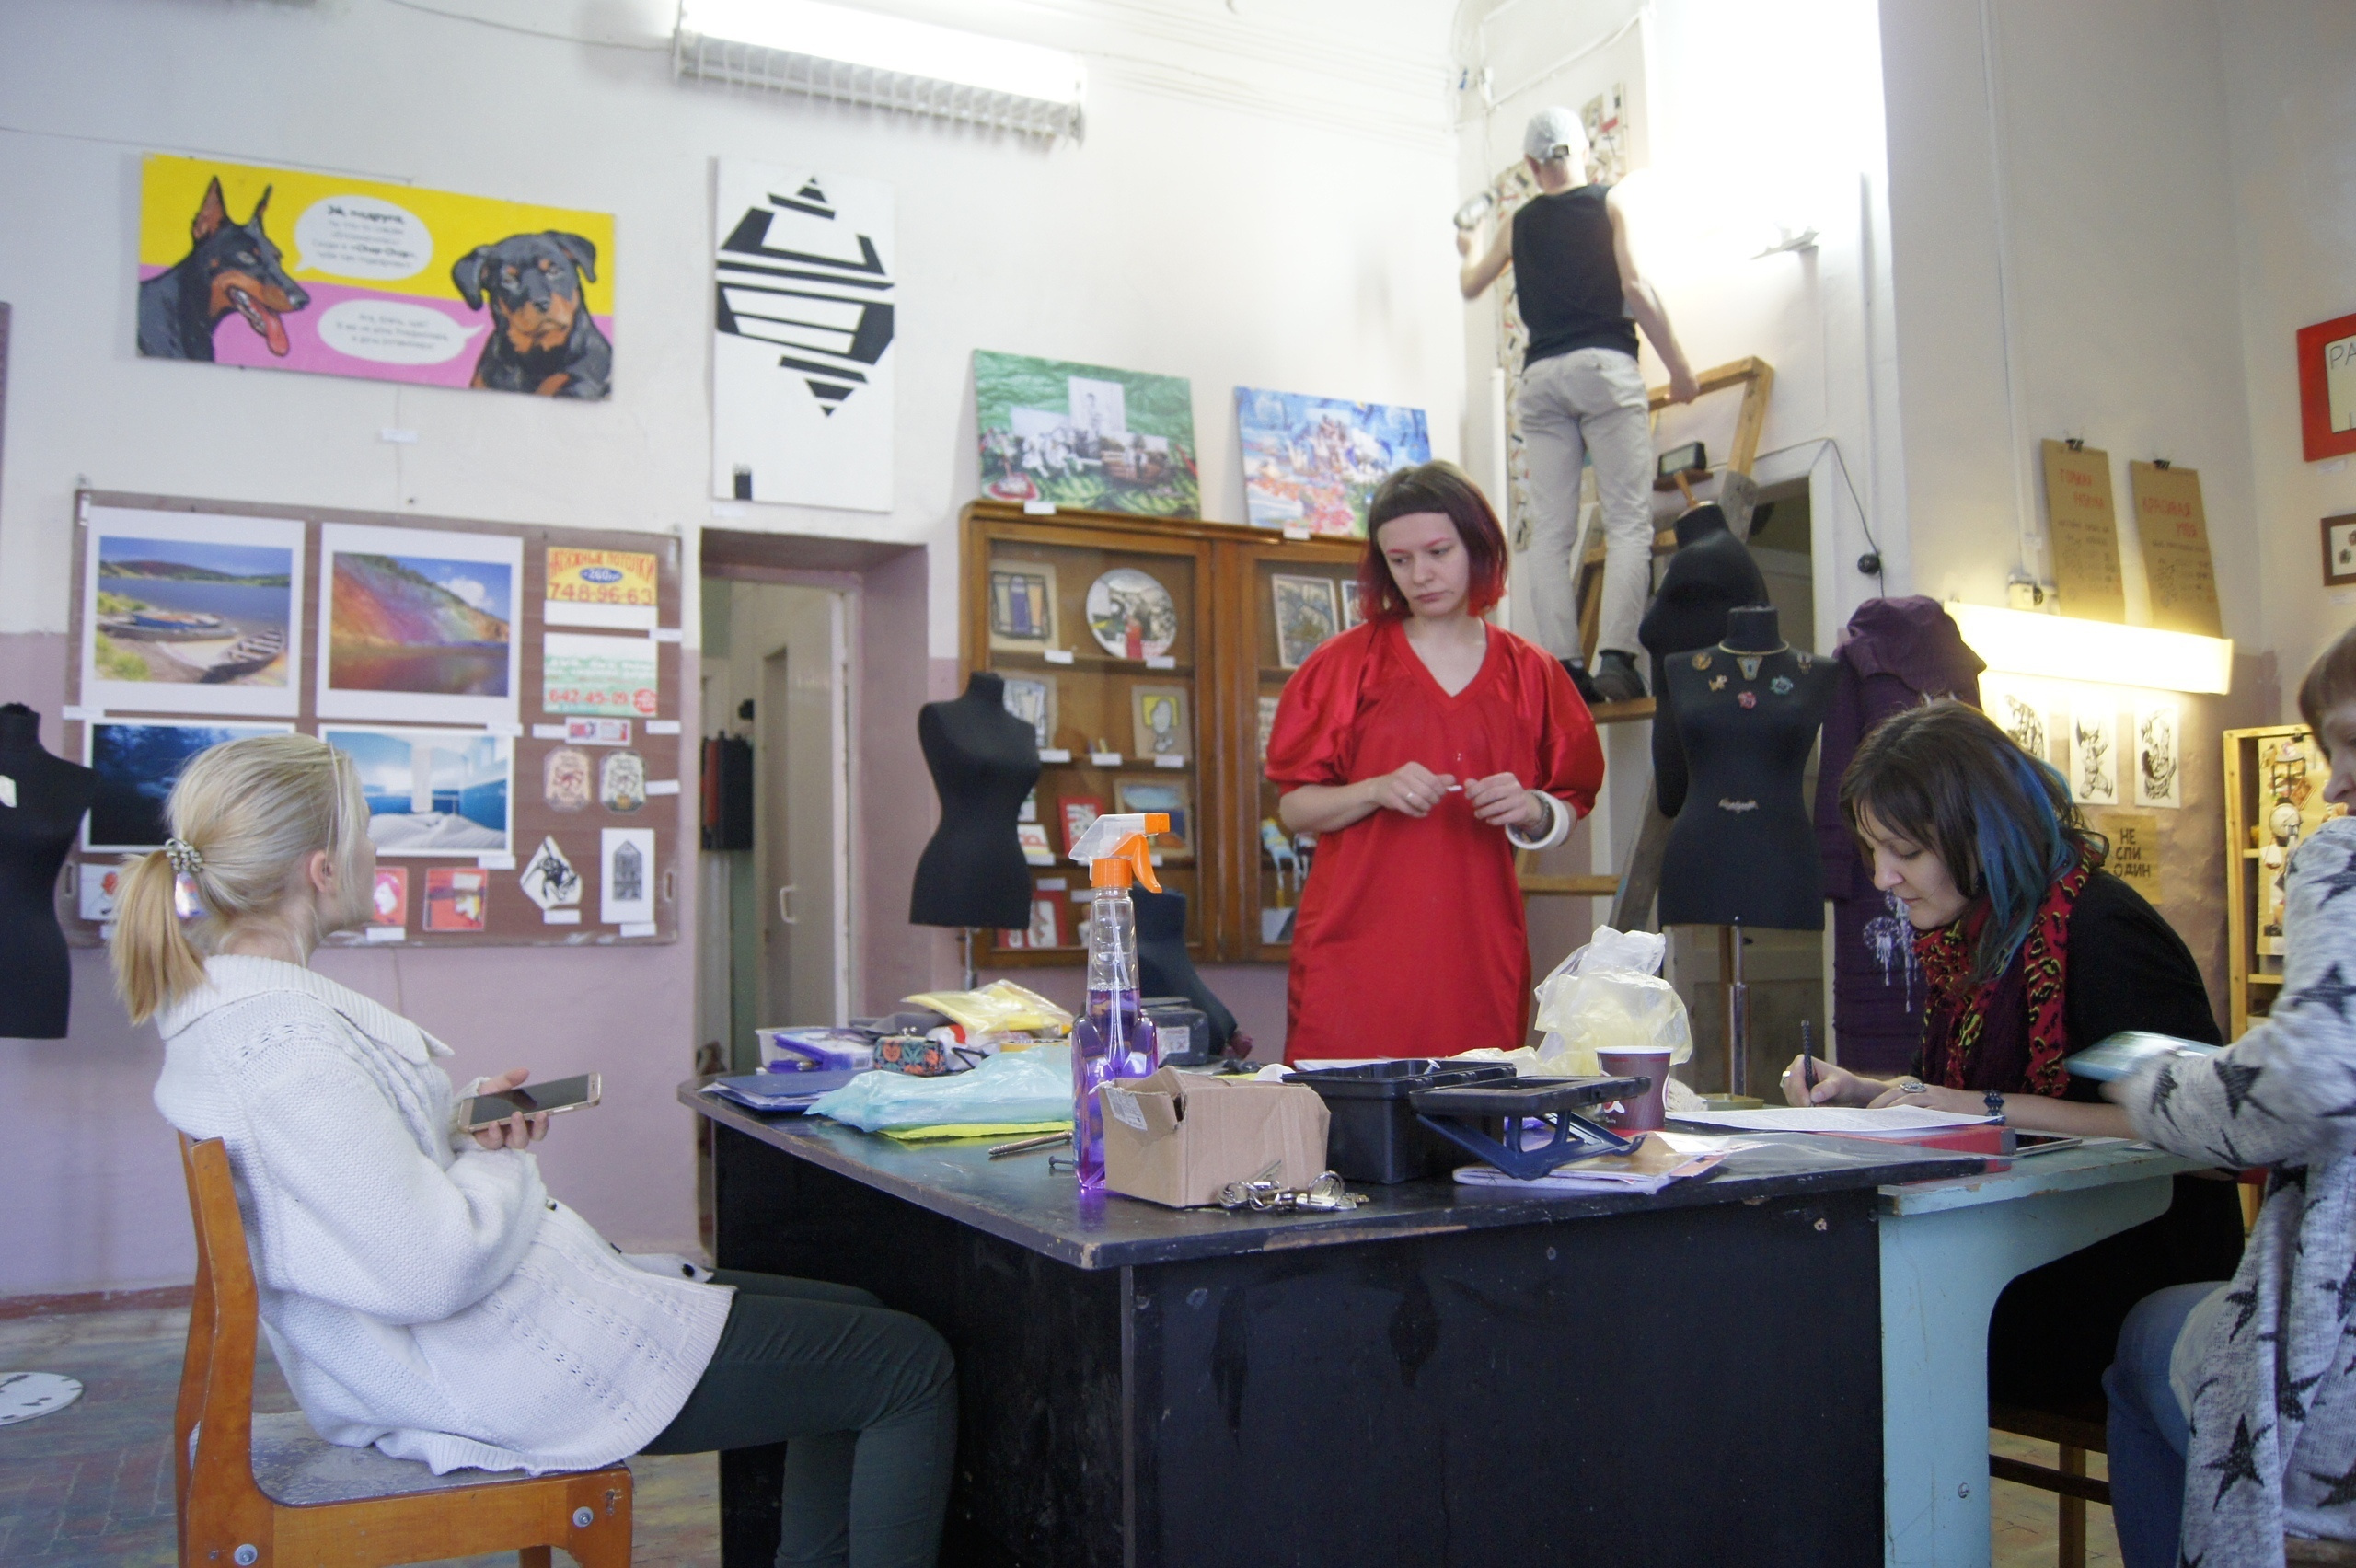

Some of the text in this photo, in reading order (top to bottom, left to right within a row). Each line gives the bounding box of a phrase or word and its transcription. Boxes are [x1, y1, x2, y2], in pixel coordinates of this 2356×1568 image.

[2120, 828, 2135, 844] НЕ
[2116, 847, 2141, 860] СПИ
[2114, 863, 2150, 877] ОДИН
